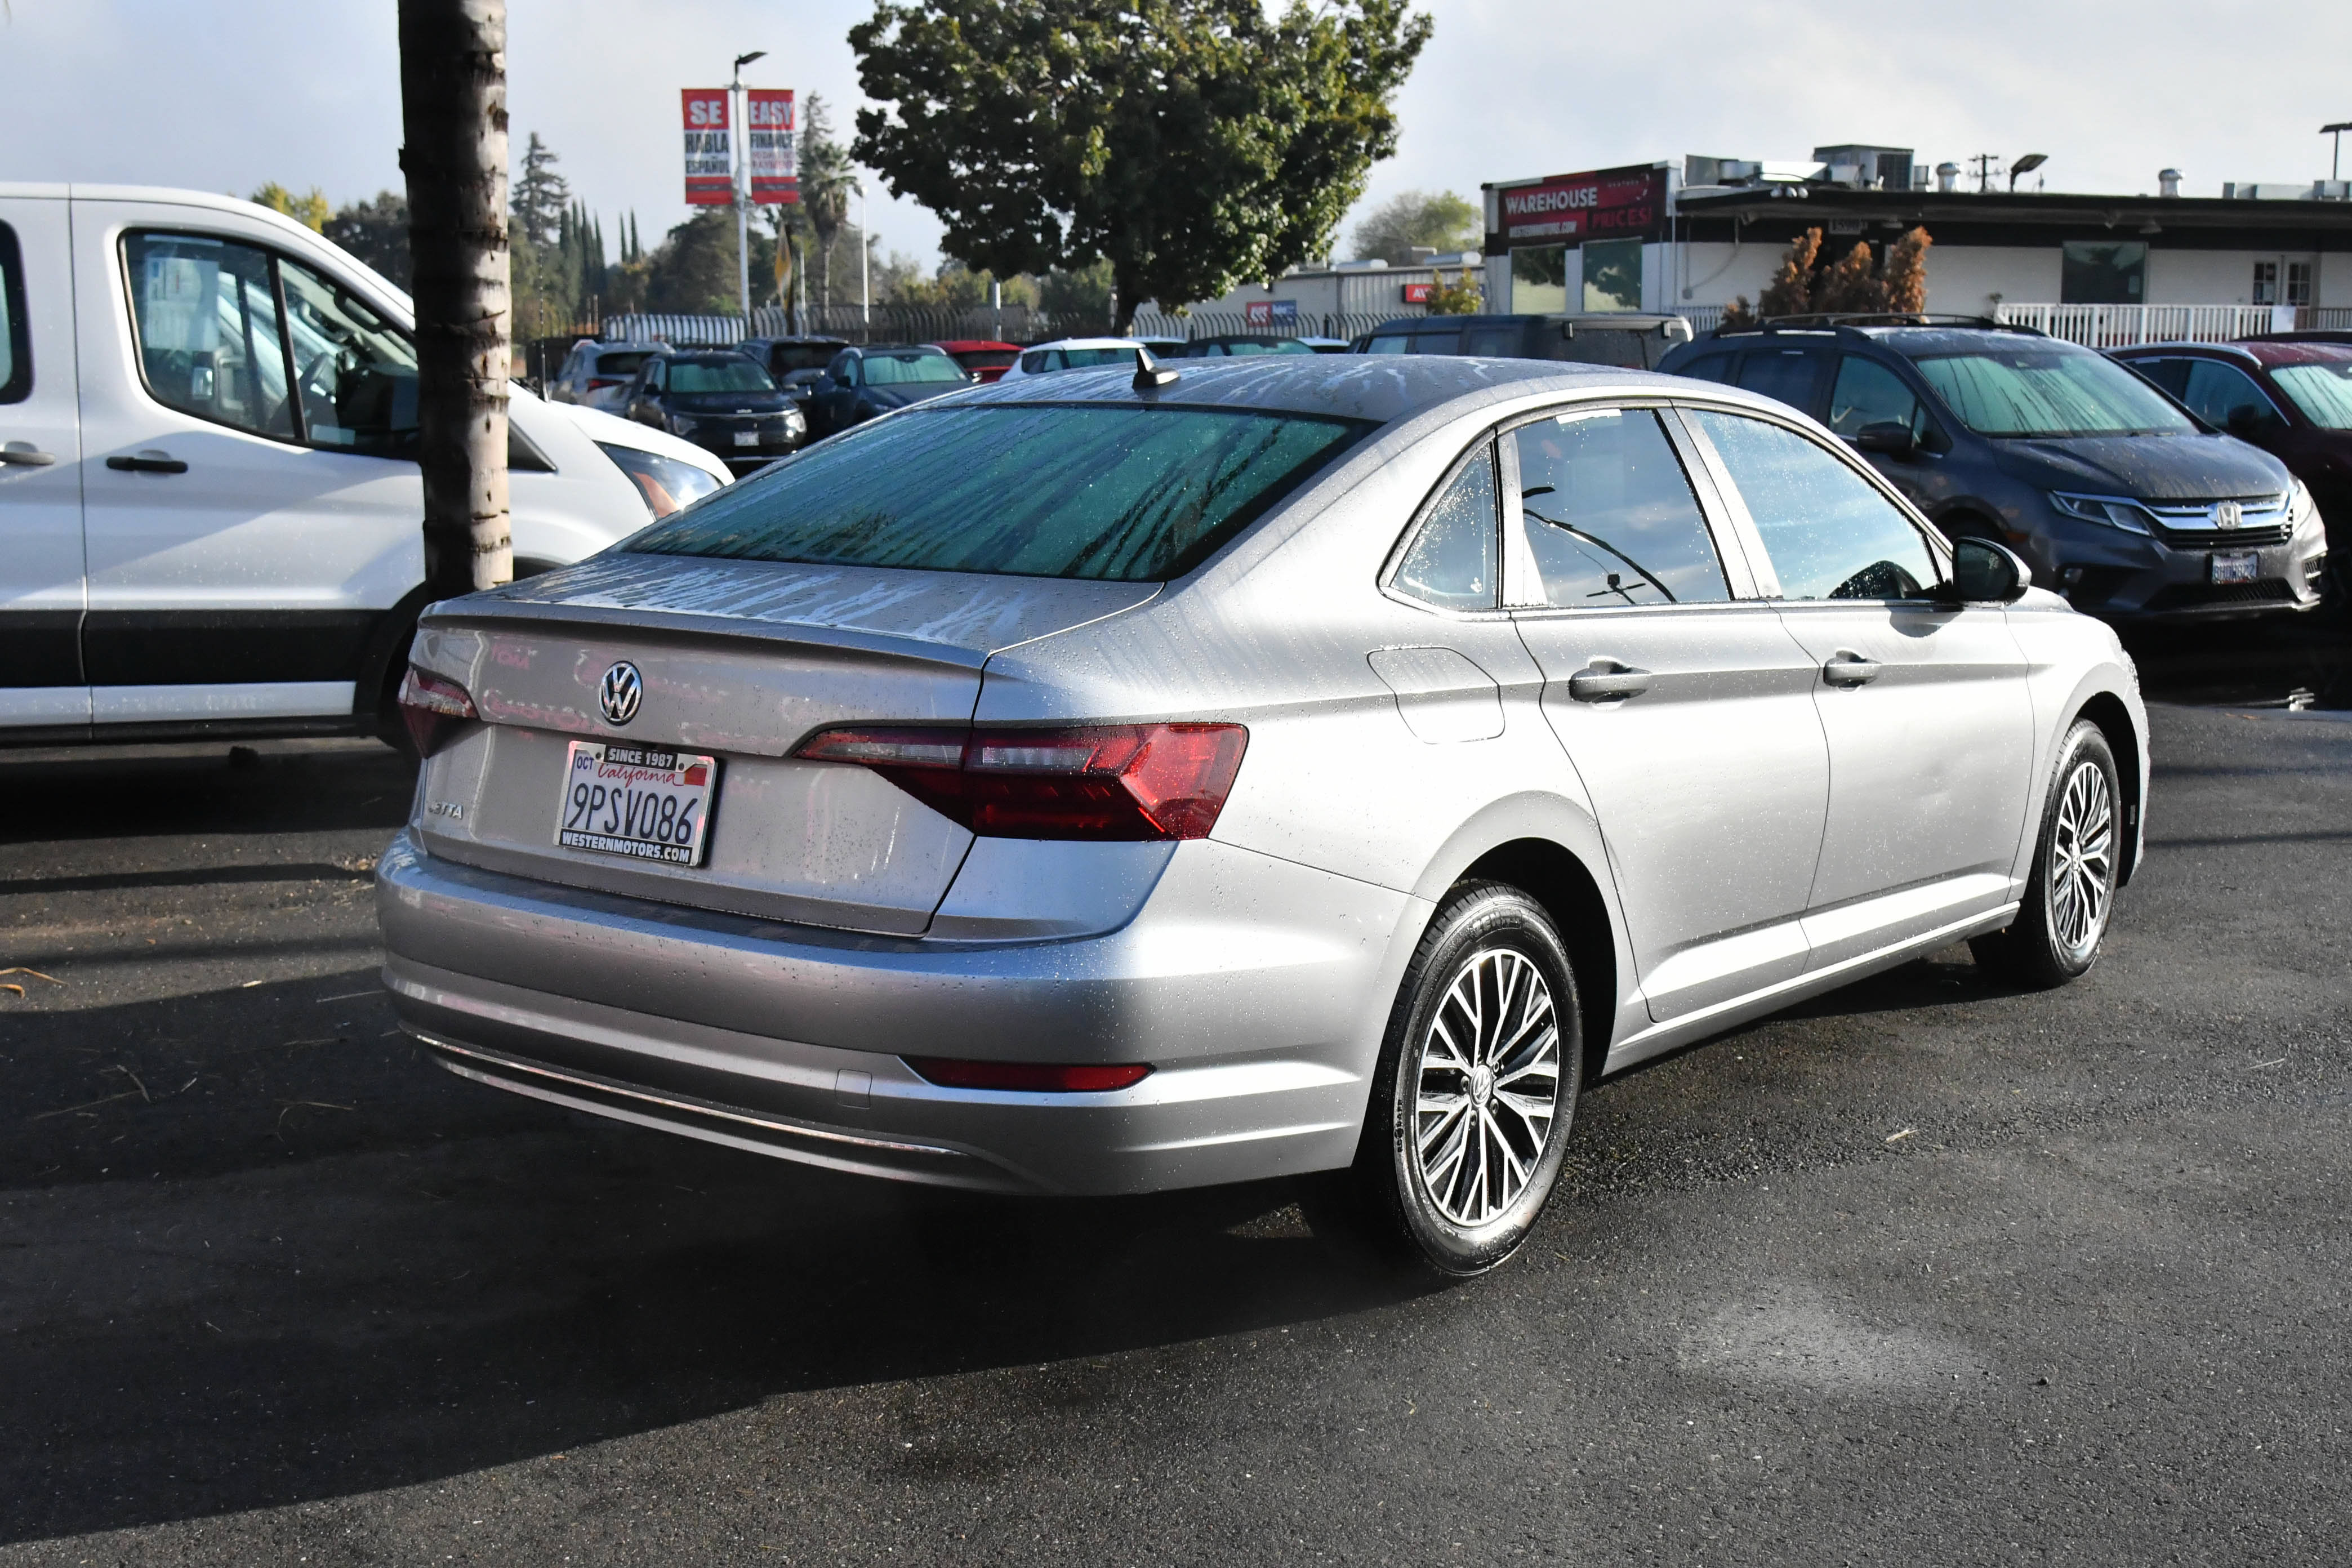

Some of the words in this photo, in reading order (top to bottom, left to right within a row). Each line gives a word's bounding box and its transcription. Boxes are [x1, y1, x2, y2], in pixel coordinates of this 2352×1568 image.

[689, 100, 723, 124] SE
[749, 101, 792, 125] EASY
[685, 133, 729, 153] HABLA
[1505, 186, 1598, 215] WAREHOUSE
[577, 756, 594, 770] OCT
[609, 748, 642, 764] SINCE
[646, 752, 673, 768] 1987
[598, 763, 684, 789] California
[568, 783, 698, 844] 9PSV086
[562, 832, 690, 863] WESTERNMOTORS.COM
